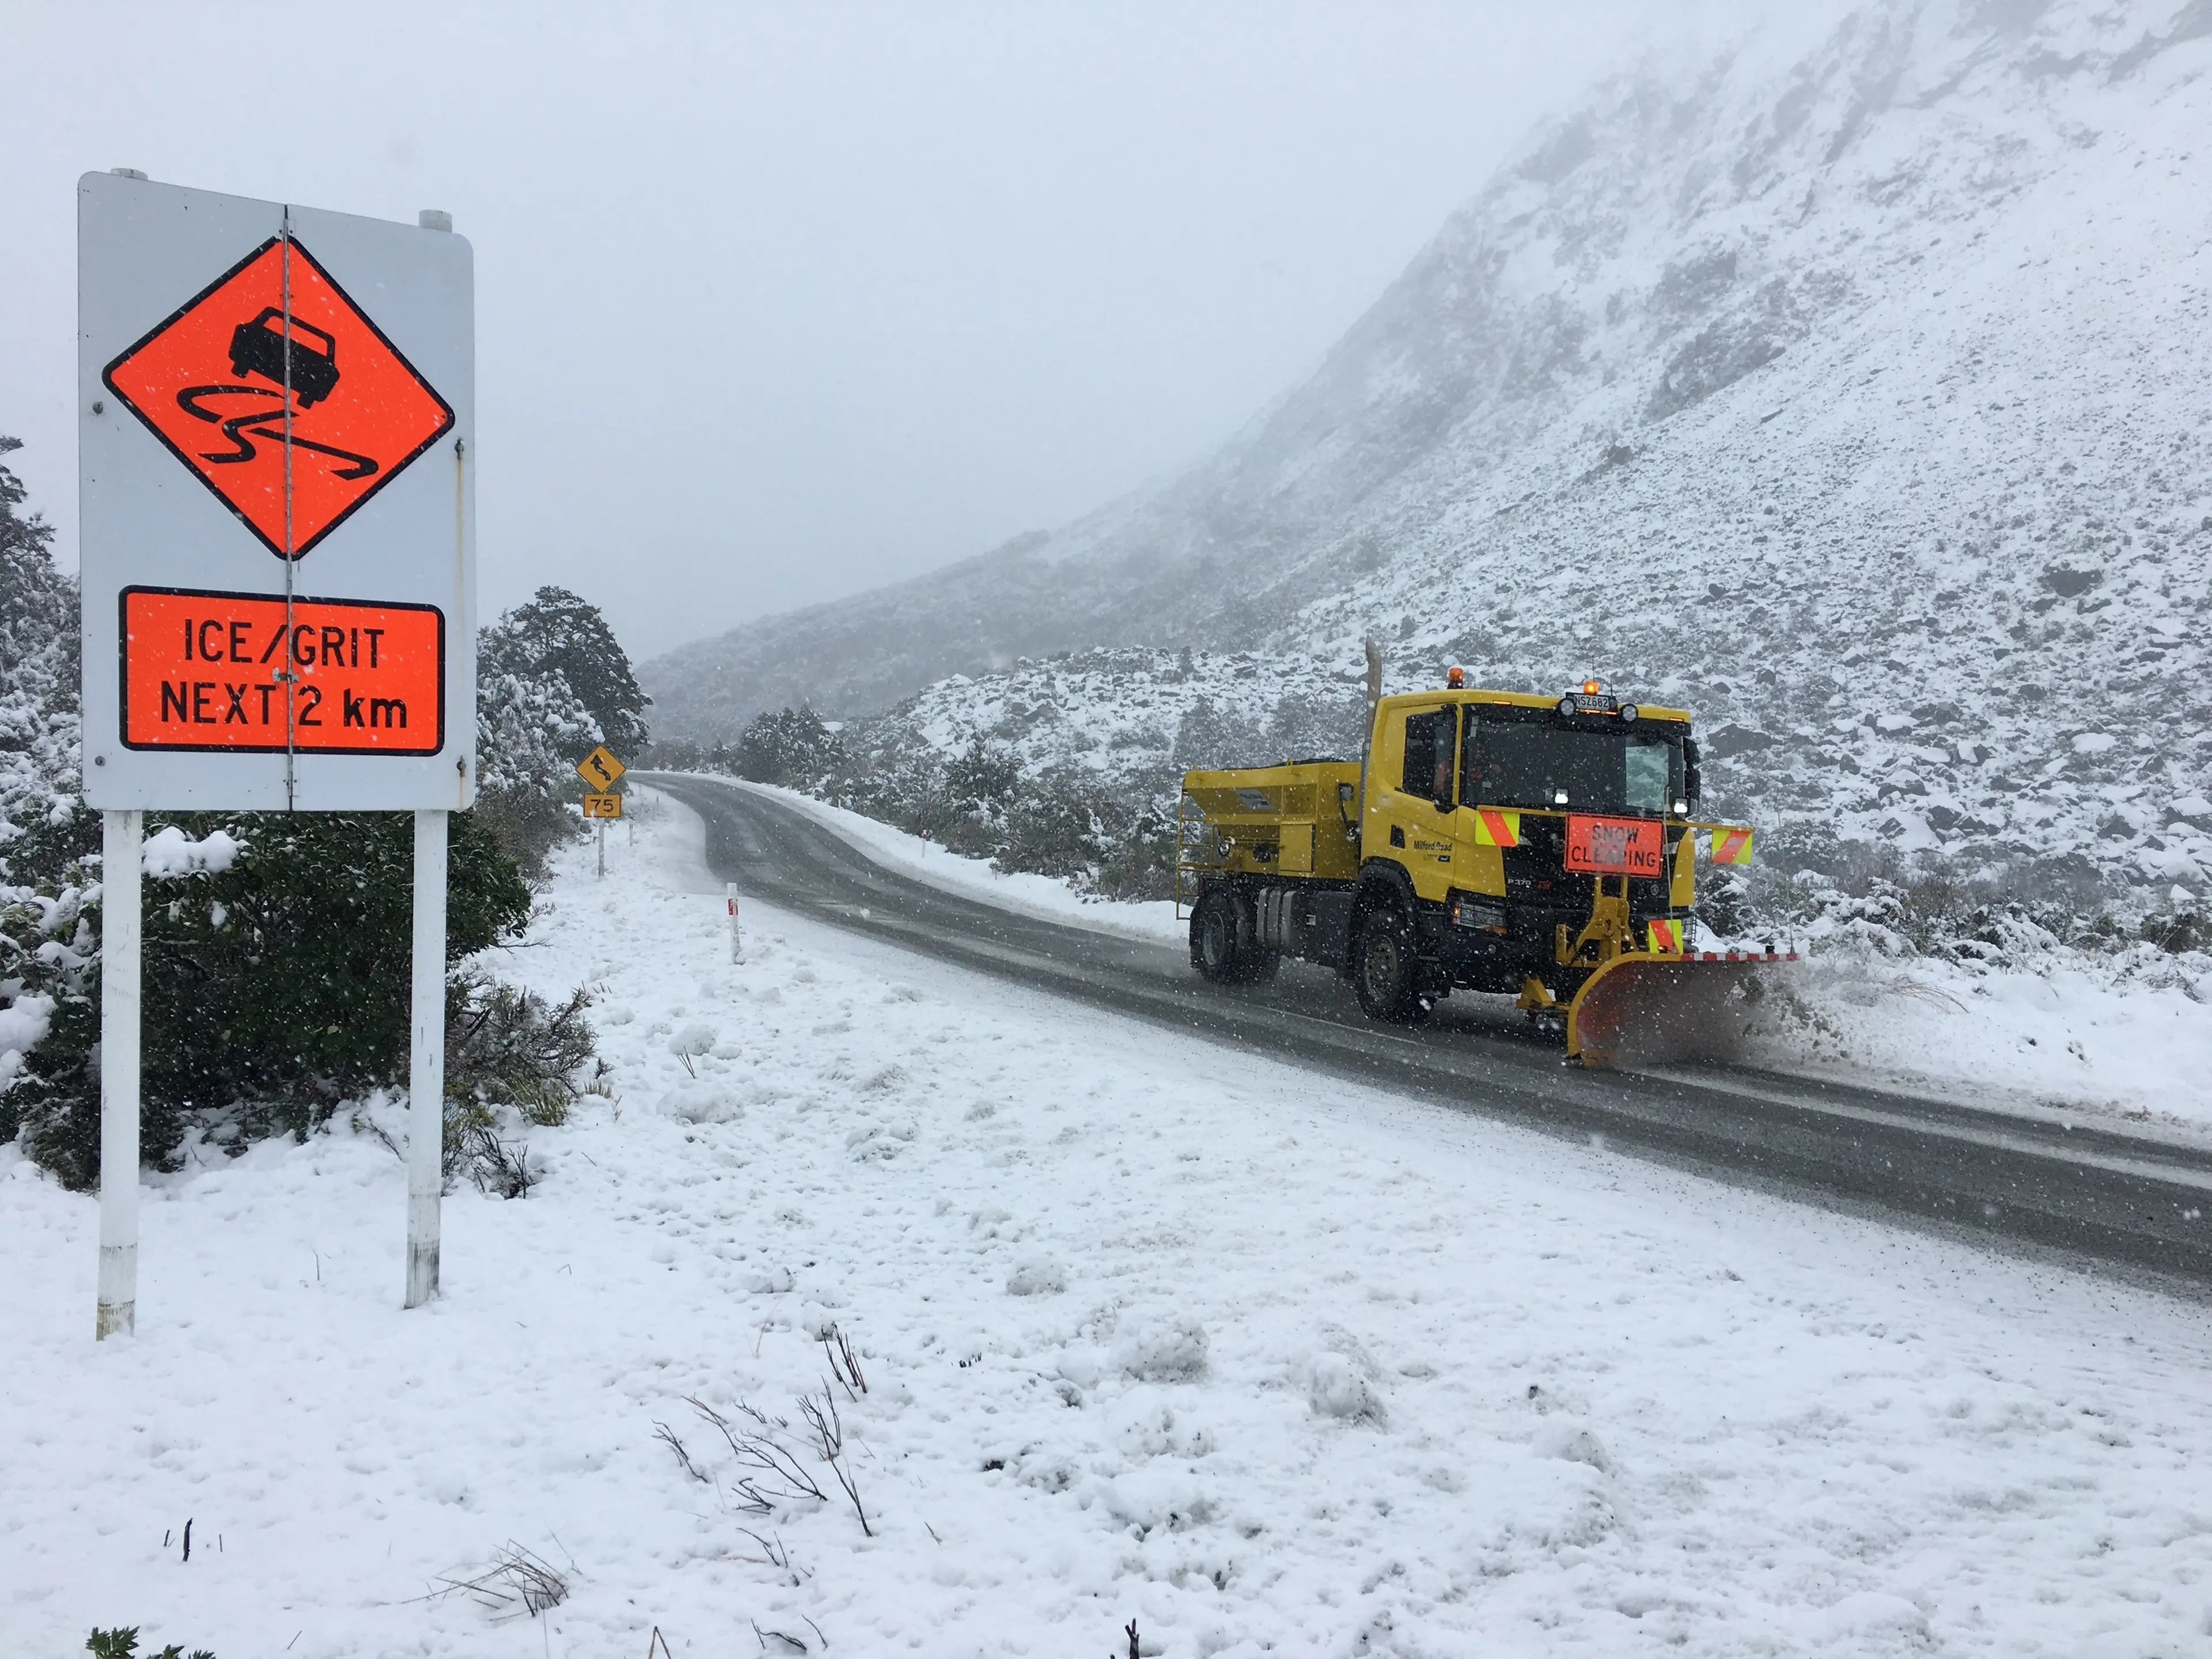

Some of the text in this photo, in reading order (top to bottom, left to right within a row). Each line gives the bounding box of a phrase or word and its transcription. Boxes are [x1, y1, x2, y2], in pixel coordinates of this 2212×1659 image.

[185, 619, 385, 668] ICE/GRIT
[161, 680, 408, 728] NEXT 2 km
[1575, 696, 1608, 707] NSZ682
[590, 799, 614, 812] 75
[1592, 824, 1639, 843] SNOW
[1413, 840, 1452, 851] Milford Road
